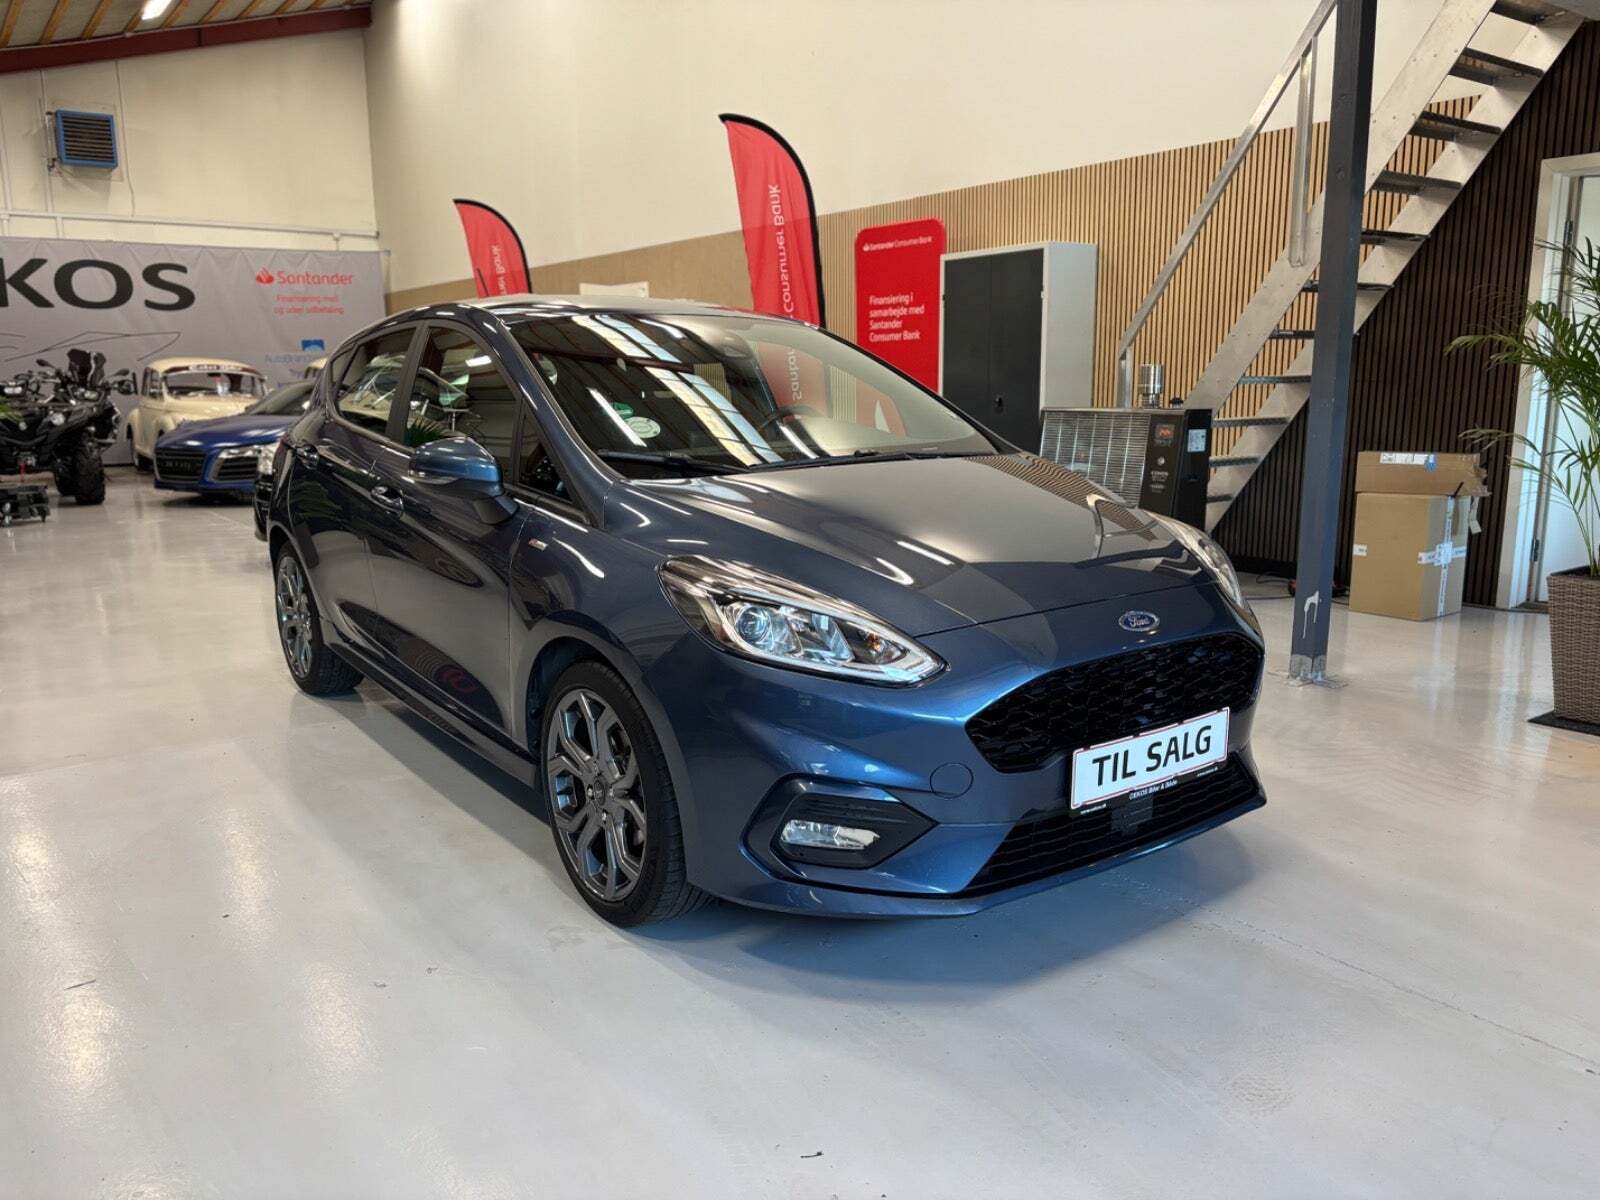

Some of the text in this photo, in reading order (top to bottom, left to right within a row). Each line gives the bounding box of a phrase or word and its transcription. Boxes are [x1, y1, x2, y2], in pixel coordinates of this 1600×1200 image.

[277, 271, 353, 285] Santander
[908, 304, 925, 315] med
[869, 320, 903, 330] Santander
[869, 330, 921, 342] Consumer Bank
[1092, 725, 1212, 787] TIL SALG
